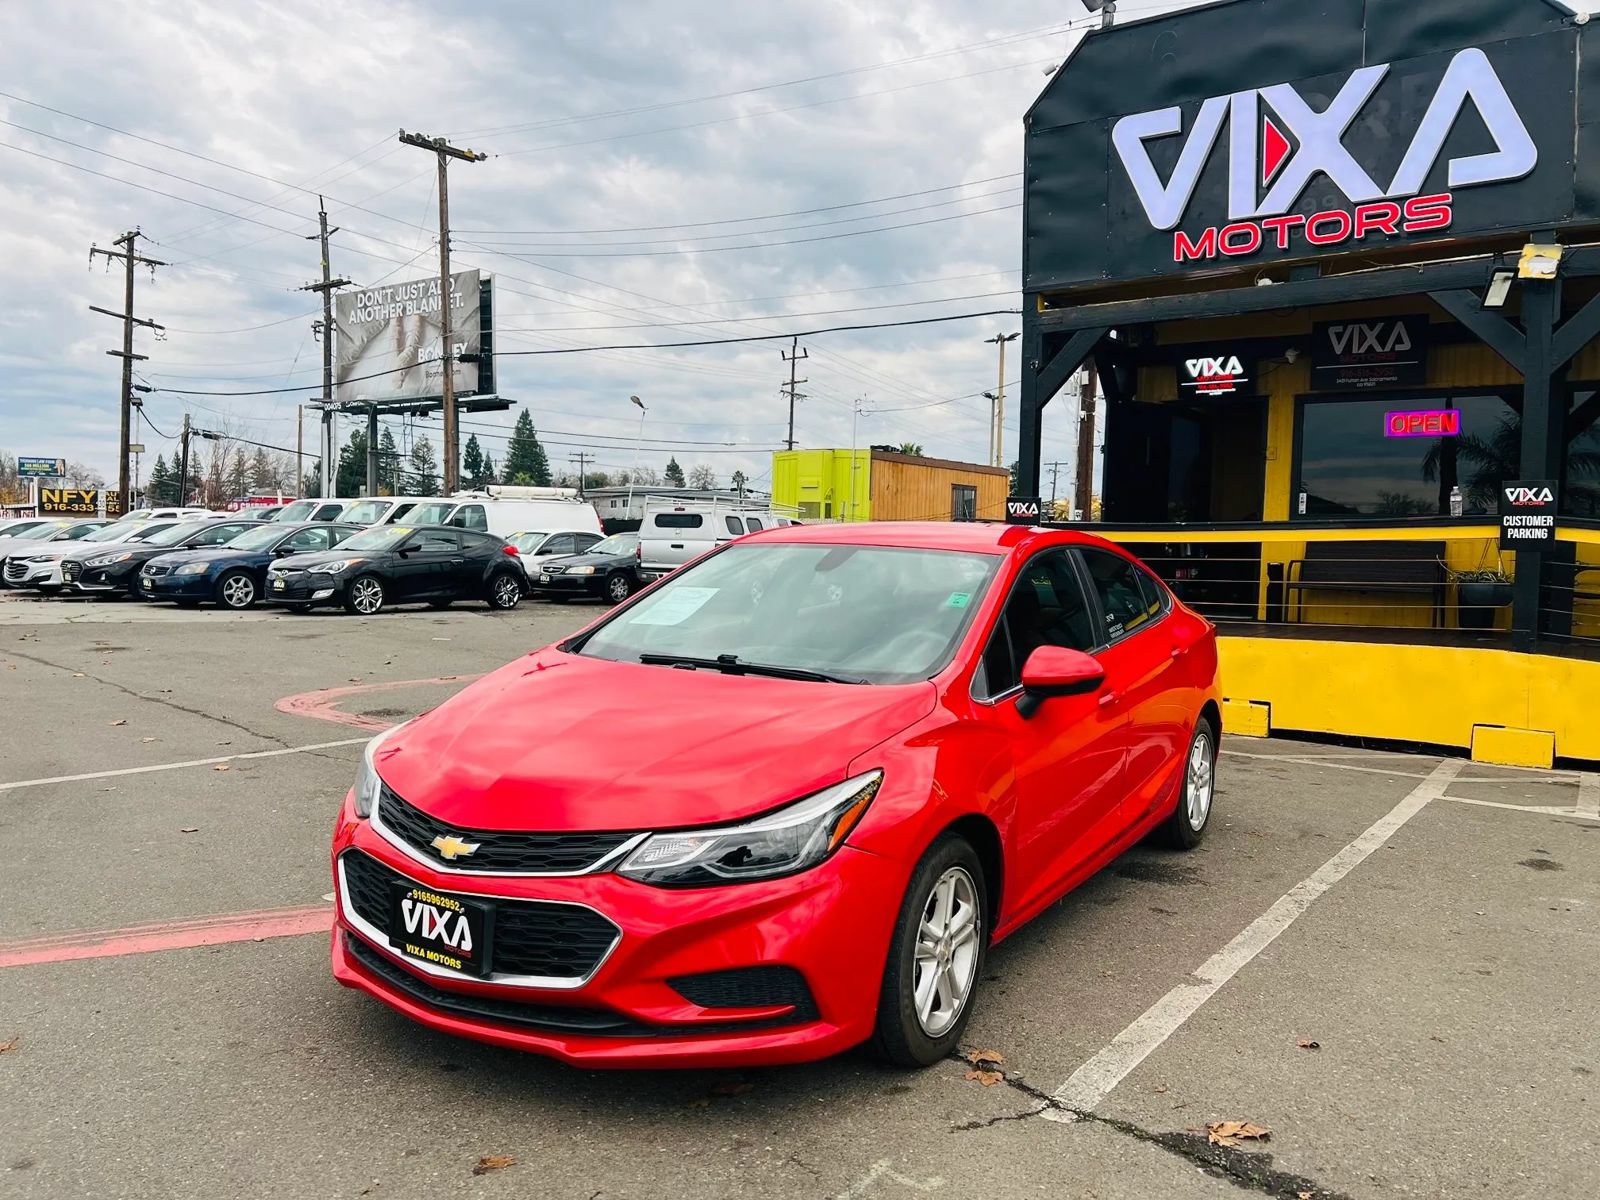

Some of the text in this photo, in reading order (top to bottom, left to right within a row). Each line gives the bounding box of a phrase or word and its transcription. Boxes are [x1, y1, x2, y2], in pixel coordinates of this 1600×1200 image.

[1111, 47, 1538, 232] VIXA
[1172, 192, 1453, 263] MOTORS
[357, 289, 393, 308] DON'T
[395, 282, 426, 300] JUST
[349, 303, 404, 324] ANOTHER
[1328, 321, 1412, 355] VIXA
[1185, 355, 1244, 377] VIXA
[1390, 413, 1457, 433] OPEN
[41, 489, 96, 504] NFY
[1505, 487, 1554, 502] VIXA
[1008, 502, 1039, 514] VIXA
[1503, 515, 1554, 526] CUSTOMER
[1507, 528, 1548, 539] PARKING
[412, 889, 460, 912] 9165962952
[401, 898, 473, 952] VIXA
[406, 943, 462, 970] VIXA MOTORS
